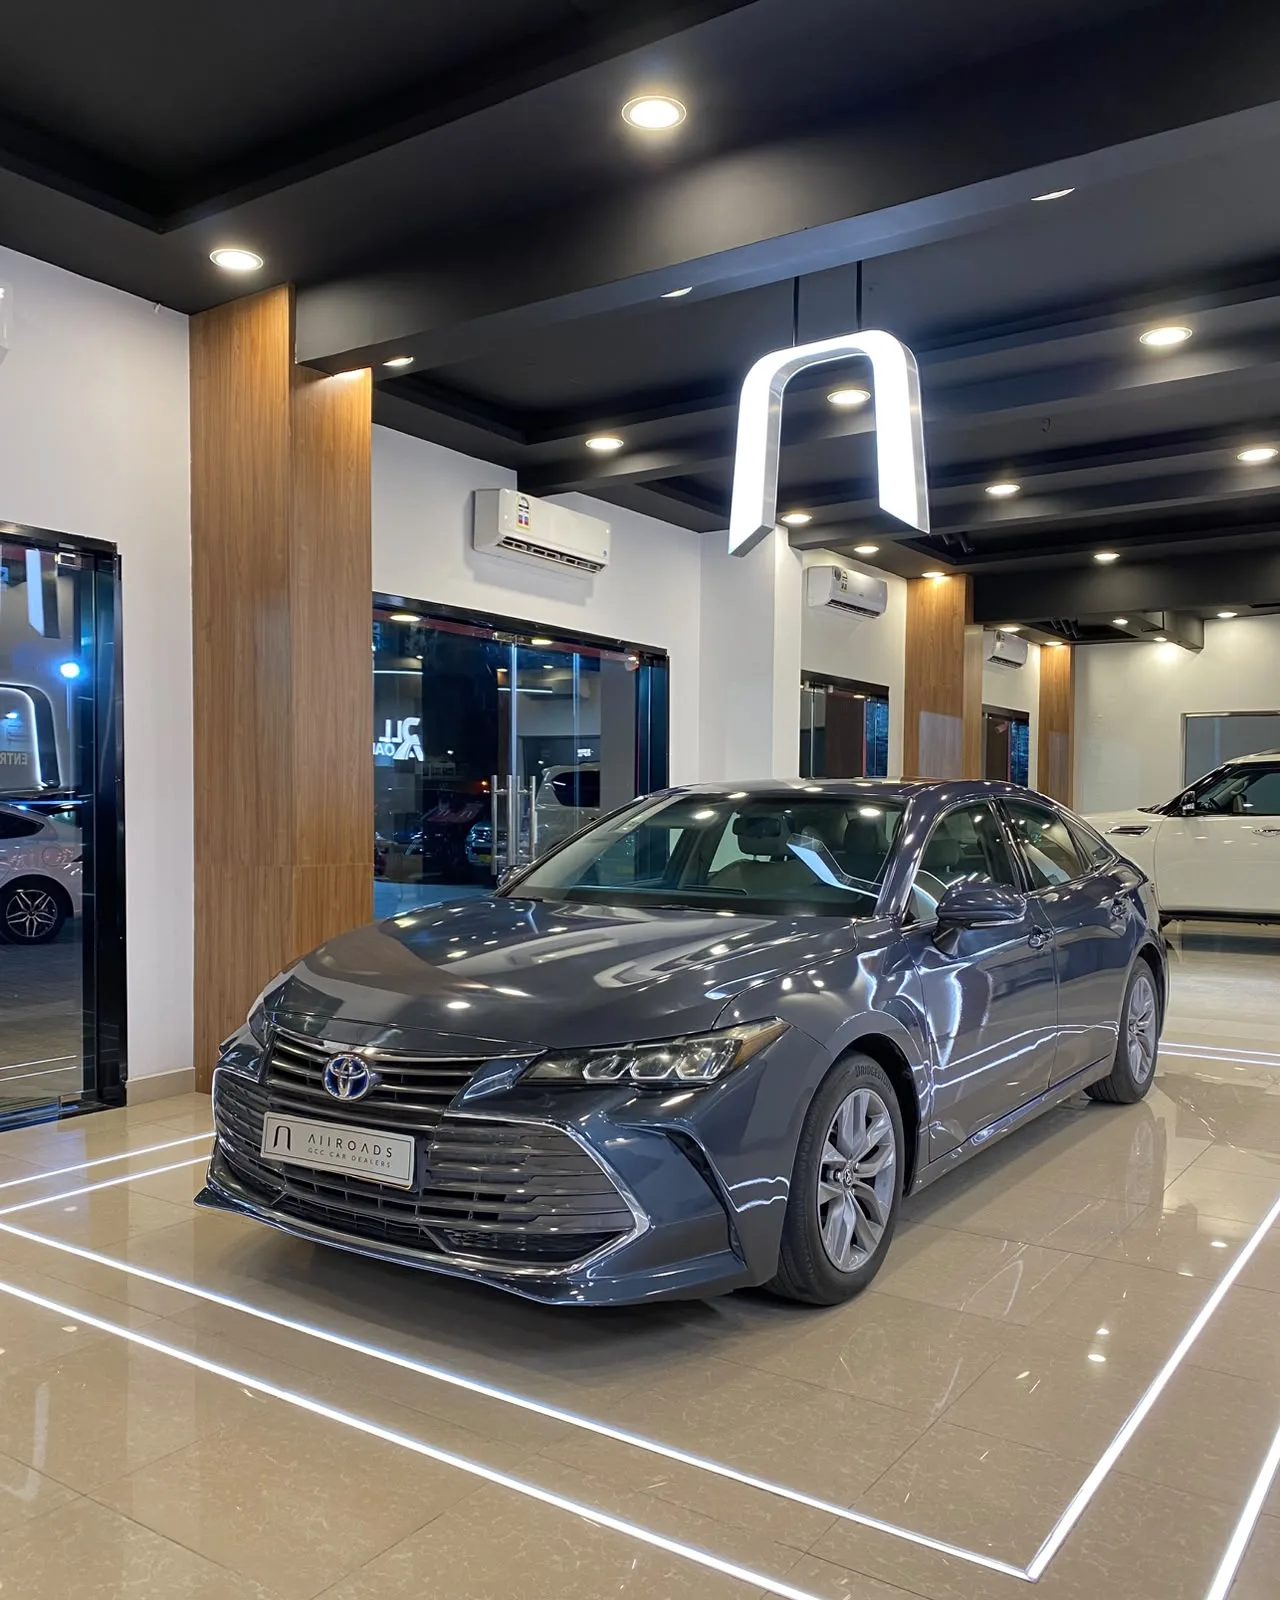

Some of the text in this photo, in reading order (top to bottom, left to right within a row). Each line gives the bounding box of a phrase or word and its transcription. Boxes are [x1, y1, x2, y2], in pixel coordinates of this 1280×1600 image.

[308, 1147, 391, 1168] GCC CAR DEALERS
